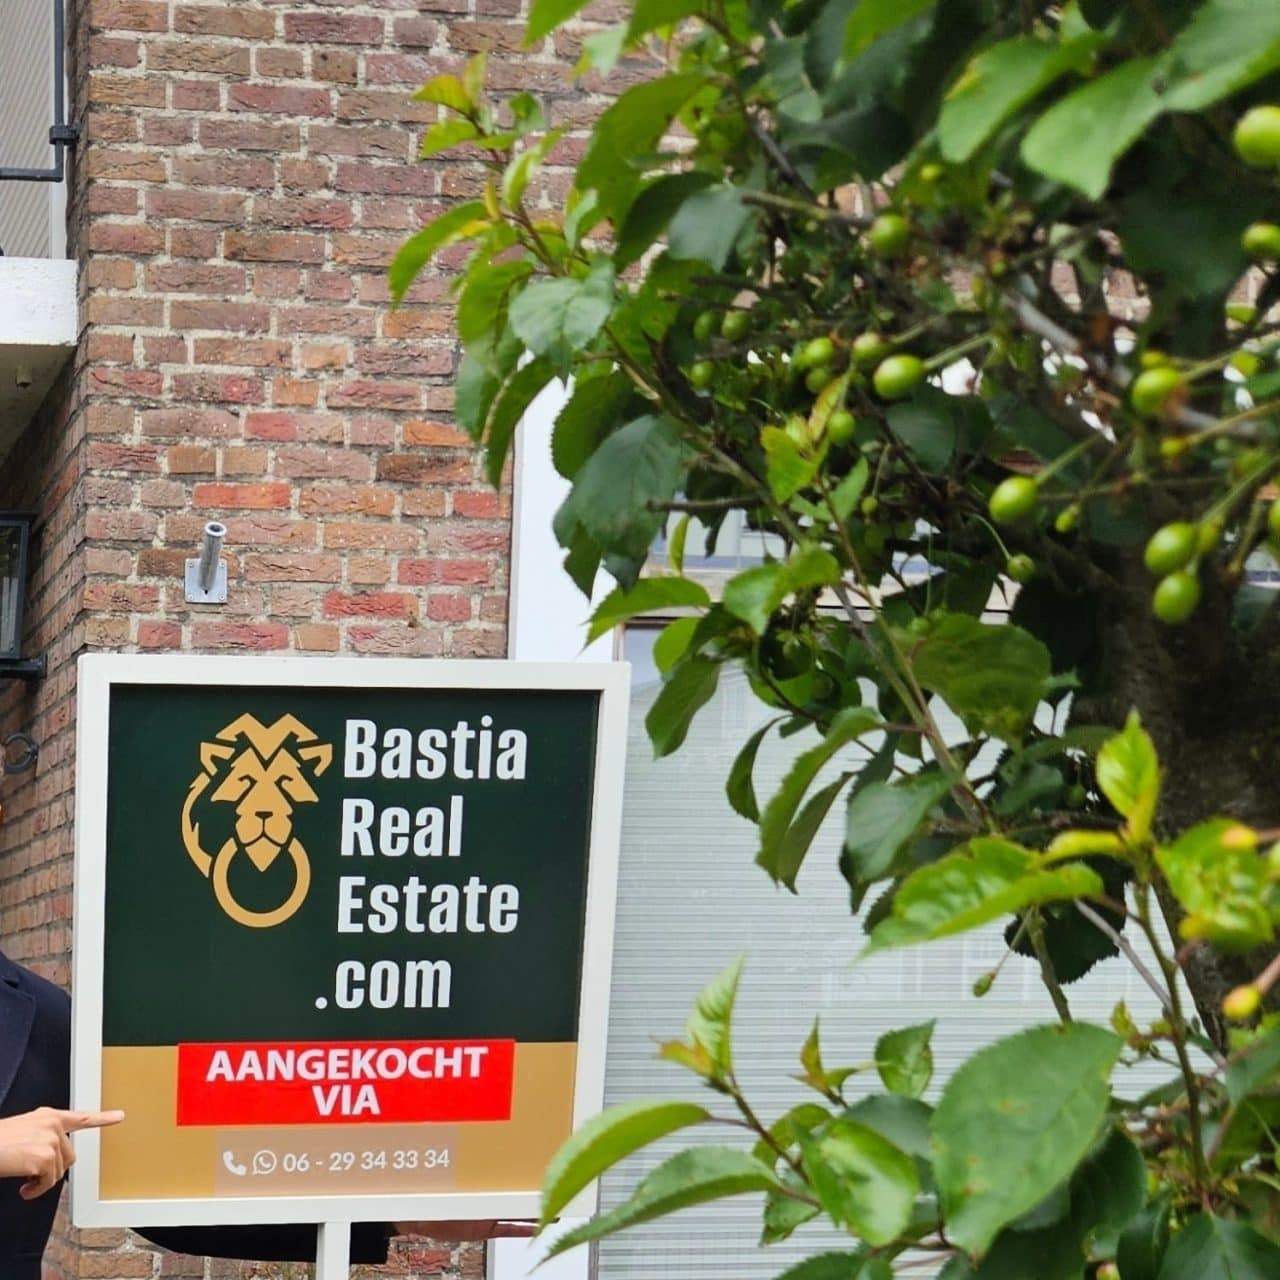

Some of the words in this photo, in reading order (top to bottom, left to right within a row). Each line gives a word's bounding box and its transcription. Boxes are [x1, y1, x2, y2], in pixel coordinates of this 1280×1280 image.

[343, 715, 528, 780] Bastia
[340, 795, 464, 857] Real
[337, 876, 519, 934] Estate
[315, 959, 452, 1010] .com
[206, 1046, 489, 1082] AANGEKOCHT
[312, 1084, 381, 1116] VIA
[282, 1152, 310, 1172] 06
[328, 1151, 356, 1172] 29
[360, 1150, 388, 1171] 34
[392, 1149, 419, 1171] 33
[423, 1148, 451, 1169] 34
